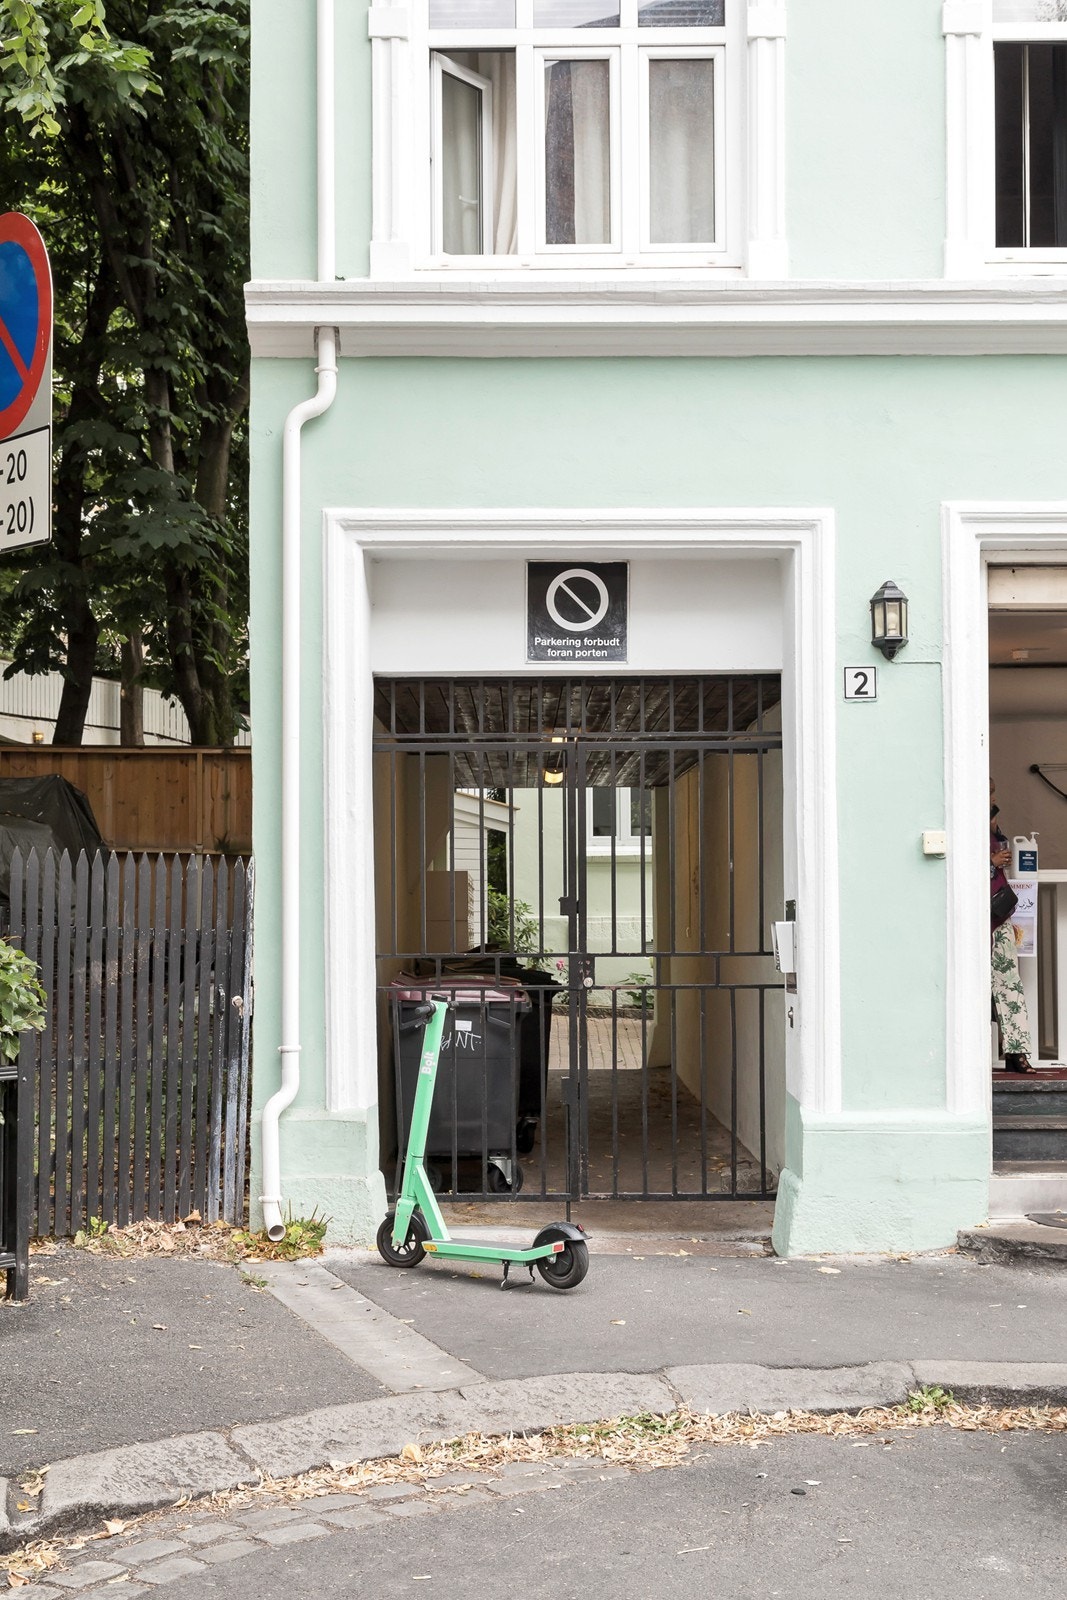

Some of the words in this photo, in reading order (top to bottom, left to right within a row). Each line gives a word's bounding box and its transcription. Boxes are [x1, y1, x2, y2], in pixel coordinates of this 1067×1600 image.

[534, 637, 581, 647] Parkering
[583, 637, 620, 646] forbudt
[547, 648, 573, 657] foran
[575, 648, 608, 658] porten
[853, 671, 868, 695] 2
[421, 1051, 436, 1075] Bolt
